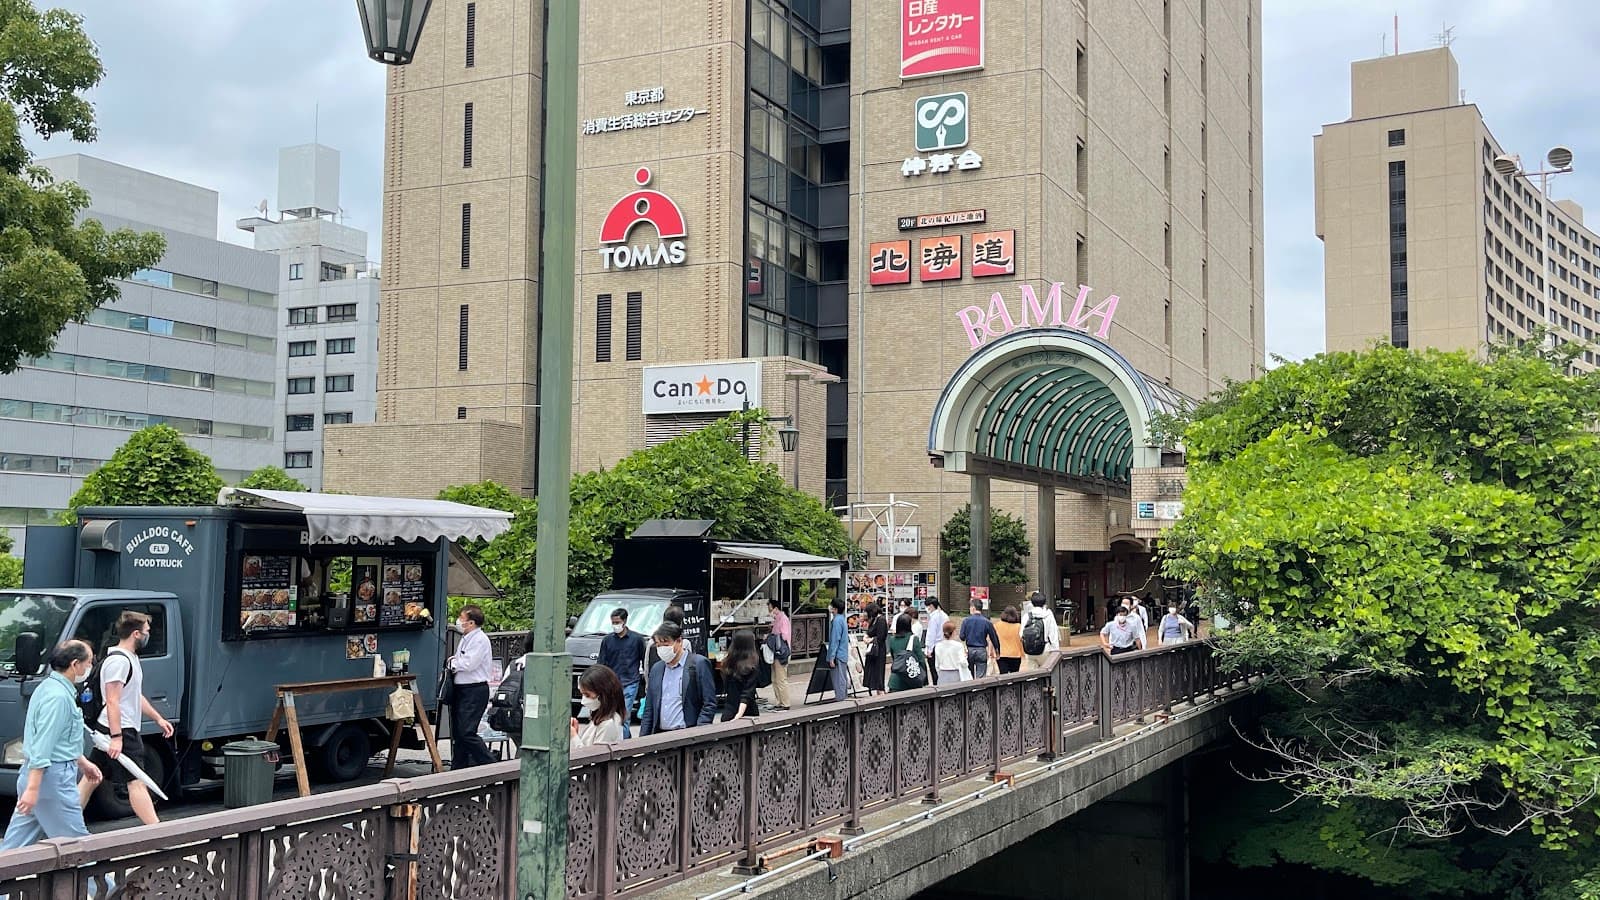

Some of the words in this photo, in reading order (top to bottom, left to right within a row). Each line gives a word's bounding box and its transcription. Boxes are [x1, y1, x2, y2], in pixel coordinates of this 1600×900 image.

[909, 0, 938, 17] 日産
[909, 13, 974, 36] レンタカー
[625, 86, 665, 106] 東京都
[583, 107, 707, 134] 消費生活総合センター
[599, 240, 686, 269] TOMAS
[873, 238, 1010, 272] 北海道
[653, 380, 693, 398] Can
[717, 378, 747, 396] Do
[126, 526, 169, 554] BULLDOG
[170, 530, 194, 556] CAFE
[153, 545, 166, 553] FLY
